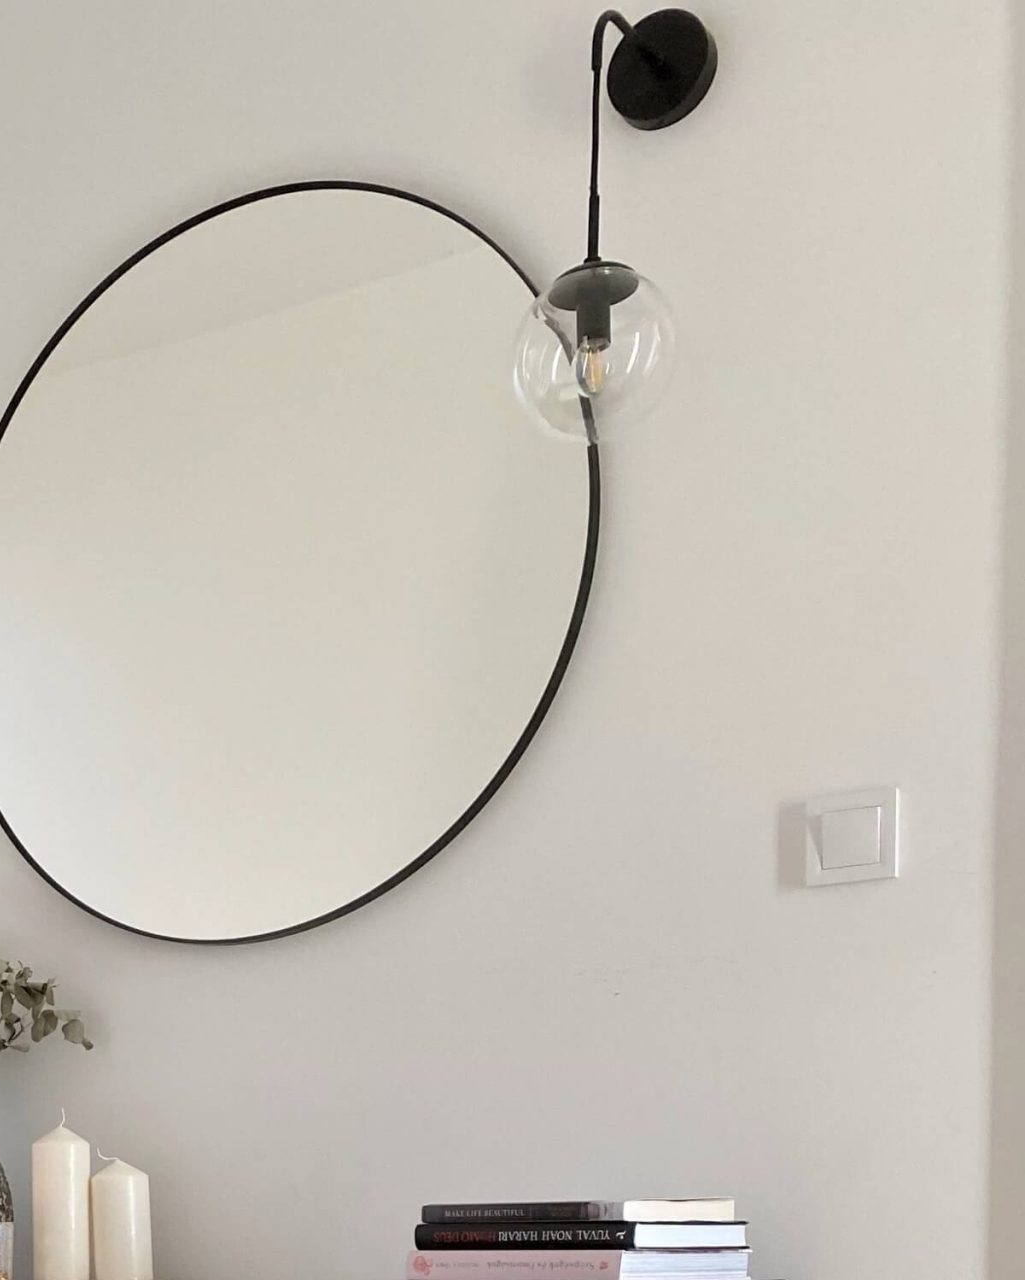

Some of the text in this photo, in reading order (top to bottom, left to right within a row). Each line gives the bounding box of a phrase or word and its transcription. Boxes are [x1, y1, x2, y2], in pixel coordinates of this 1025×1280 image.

[444, 1208, 526, 1217] MAKE LIFE BEAUTIFUL
[432, 1230, 610, 1243] YUVAL NOAH HARARI HMO DEUS
